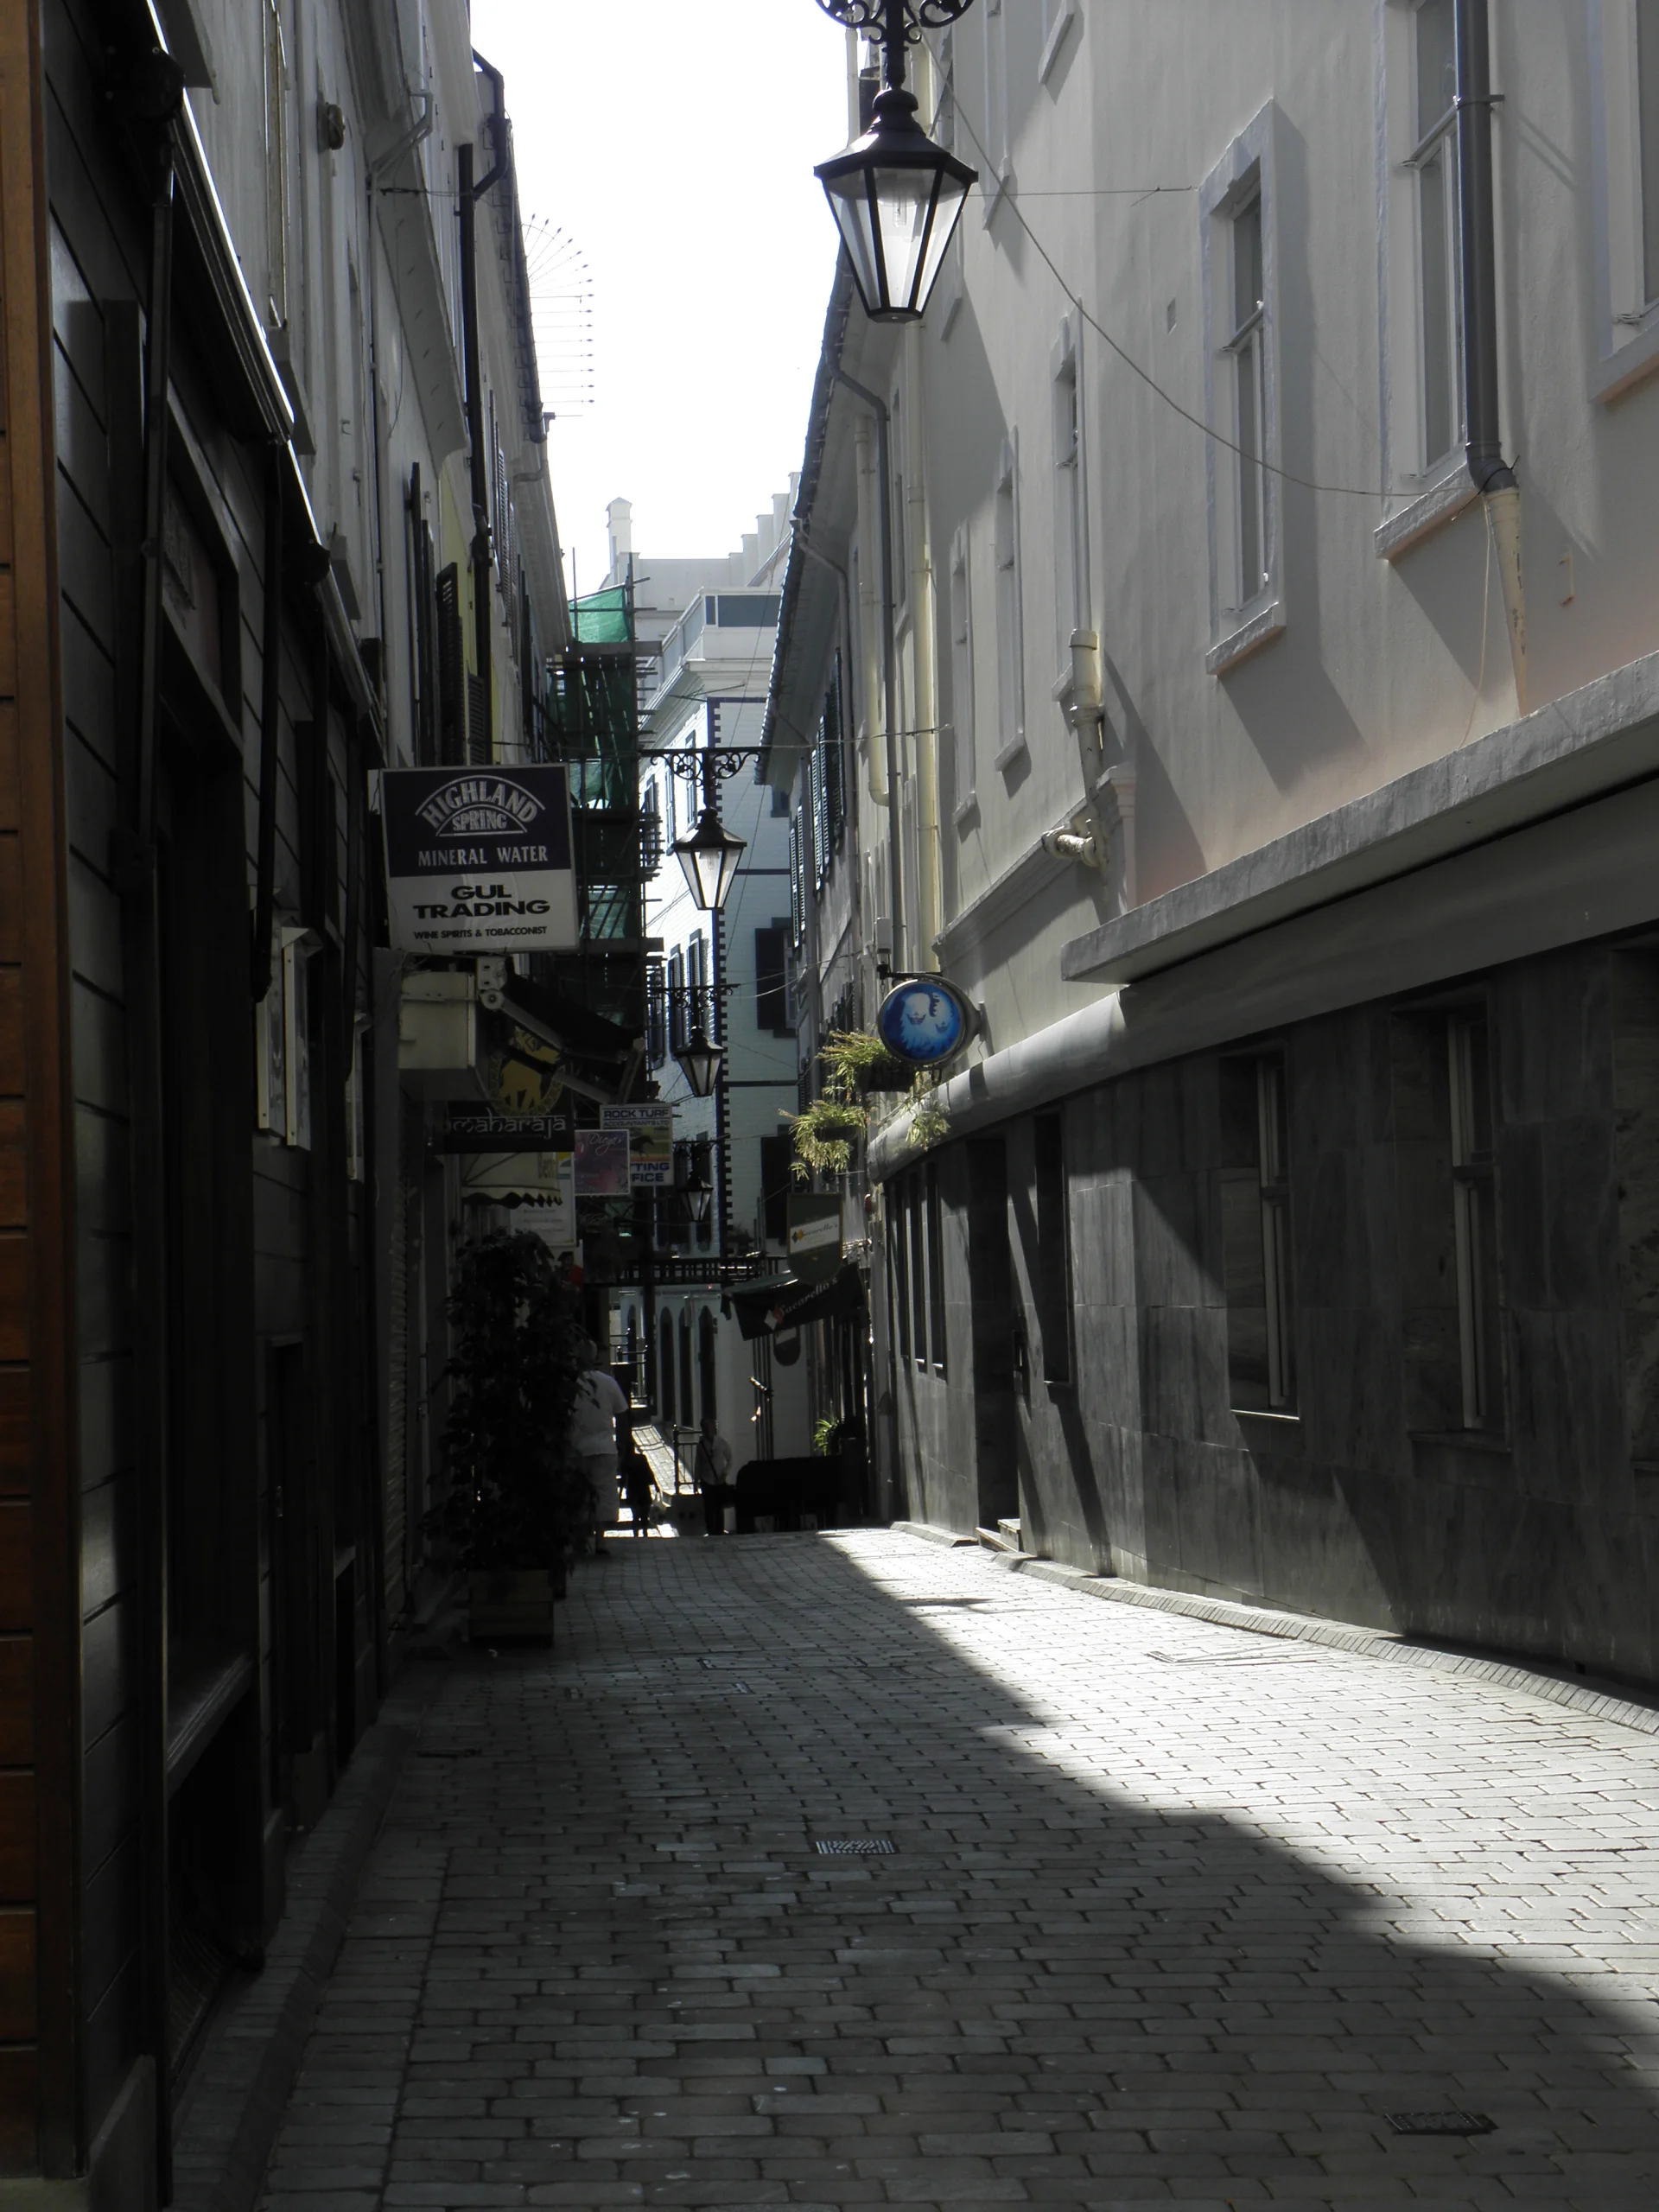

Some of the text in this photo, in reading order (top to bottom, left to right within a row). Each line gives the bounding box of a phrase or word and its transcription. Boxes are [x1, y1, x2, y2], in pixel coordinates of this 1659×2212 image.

[422, 781, 537, 830] HIGHLAND
[453, 810, 507, 831] SPRING
[418, 845, 548, 867] MINERAL WATER
[451, 884, 512, 900] GUL
[413, 899, 550, 919] TRADING
[414, 926, 547, 939] WINE SPIRITS & TOBACCONIST
[451, 1107, 567, 1139] maharaja
[604, 1109, 669, 1118] ROCK TURF
[631, 1162, 670, 1172] TING
[632, 1173, 664, 1183] FICE
[779, 1276, 838, 1317] Sacarellos
